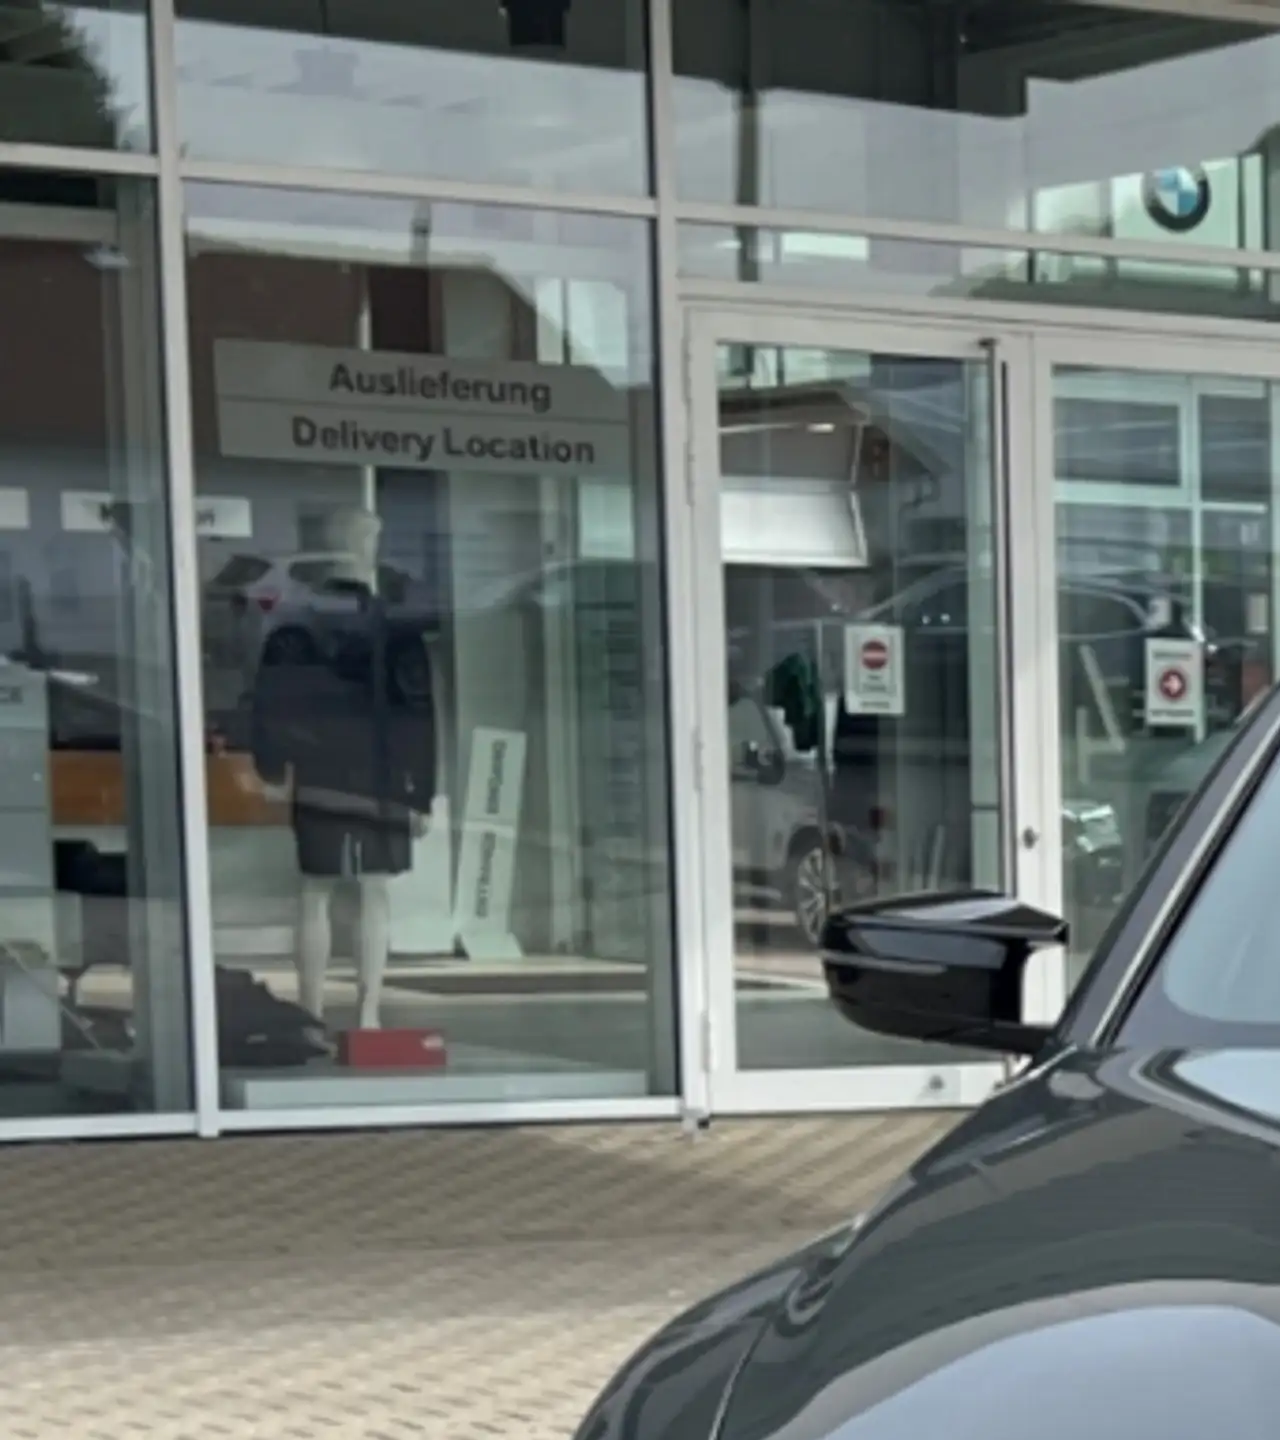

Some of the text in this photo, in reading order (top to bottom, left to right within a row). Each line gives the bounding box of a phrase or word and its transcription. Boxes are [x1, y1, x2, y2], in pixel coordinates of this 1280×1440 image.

[330, 363, 552, 414] Auslieferung
[292, 415, 596, 464] Delivery Location
